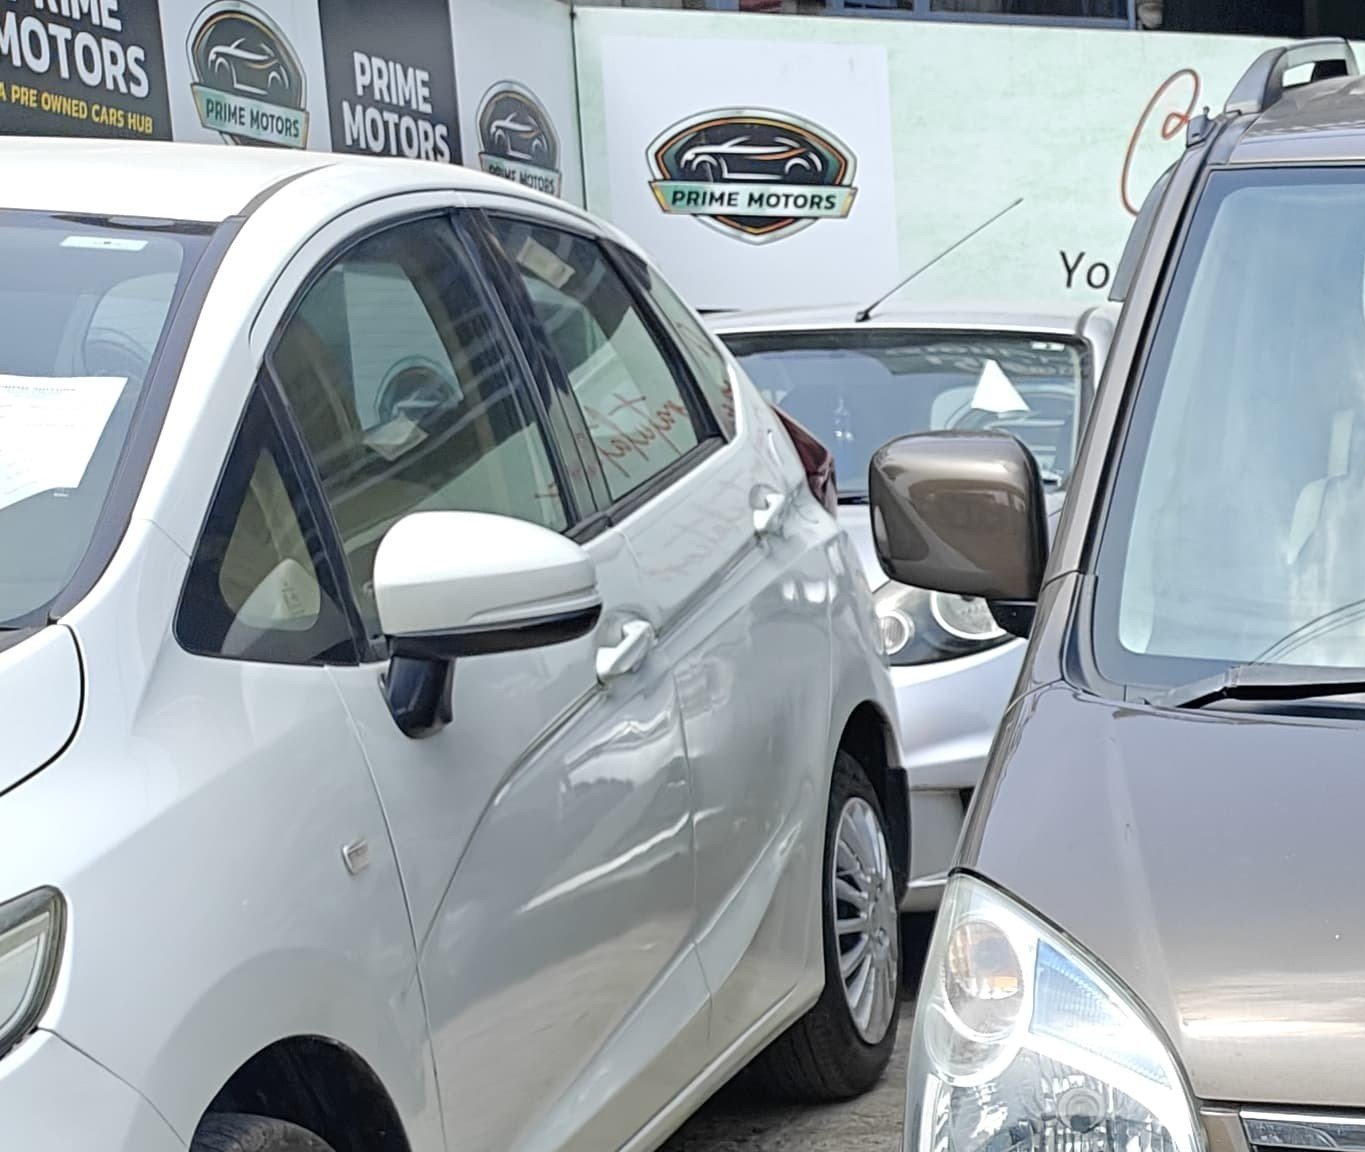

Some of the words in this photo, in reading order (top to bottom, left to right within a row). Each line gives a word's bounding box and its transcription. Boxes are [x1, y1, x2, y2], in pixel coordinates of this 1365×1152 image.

[0, 11, 149, 98] MOTORS
[353, 51, 432, 114] PRIME
[12, 84, 37, 109] PRE
[41, 92, 88, 119] OWNED
[91, 104, 125, 128] CARS
[128, 112, 153, 134] HUB
[206, 98, 246, 126] PRIME
[250, 108, 300, 138] MOTORS
[343, 101, 451, 163] MOTORS
[671, 189, 740, 207] PRIME
[747, 191, 837, 210] MOTORS
[1059, 249, 1110, 289] Yo
